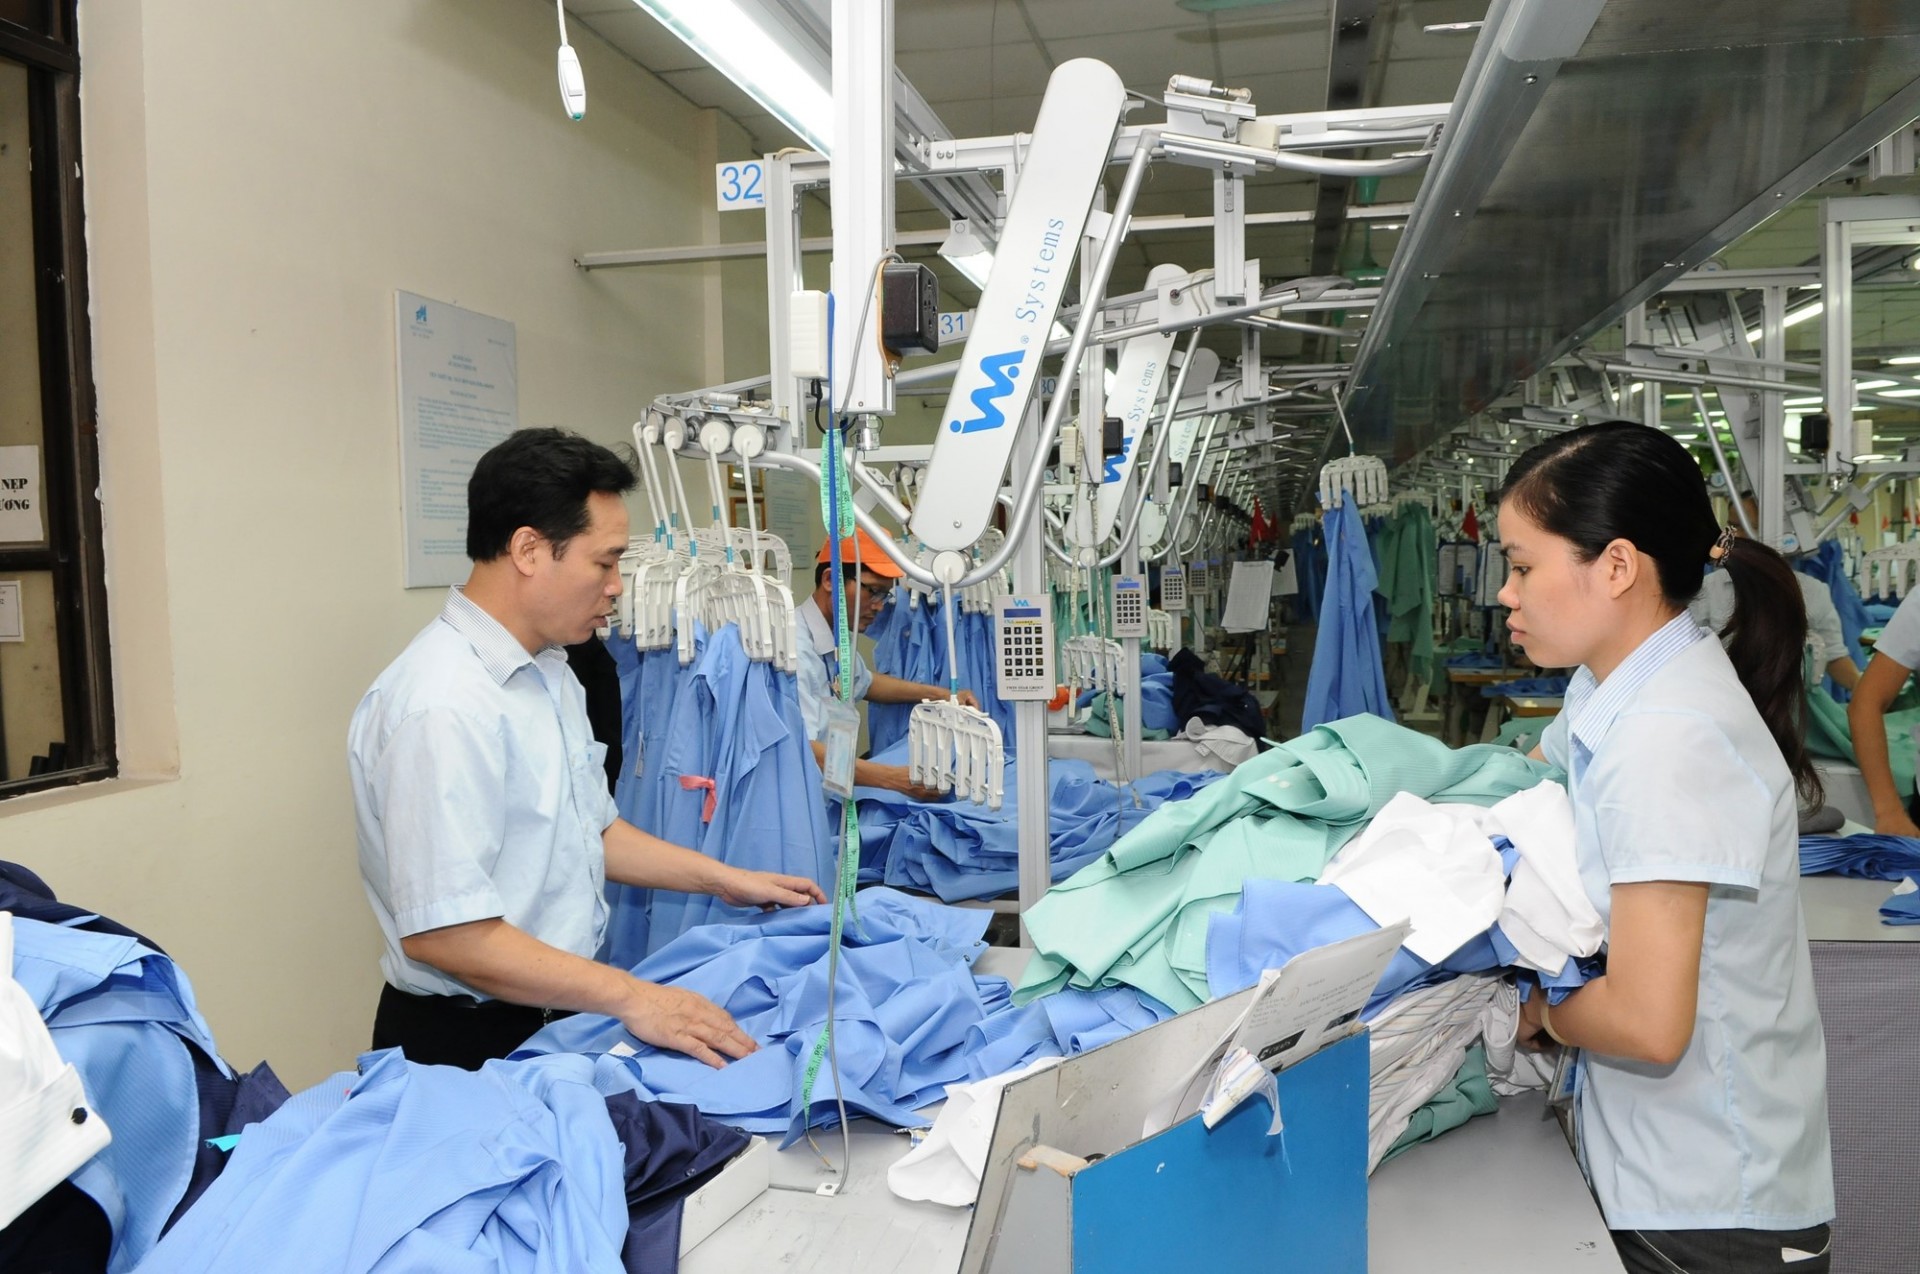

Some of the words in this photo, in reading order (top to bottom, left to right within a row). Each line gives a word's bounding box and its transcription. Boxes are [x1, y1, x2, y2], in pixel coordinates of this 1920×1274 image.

[722, 164, 762, 201] 32
[1016, 218, 1065, 323] Systems
[940, 313, 965, 336] 31
[1127, 361, 1157, 422] Systems
[1, 478, 28, 493] NẸP
